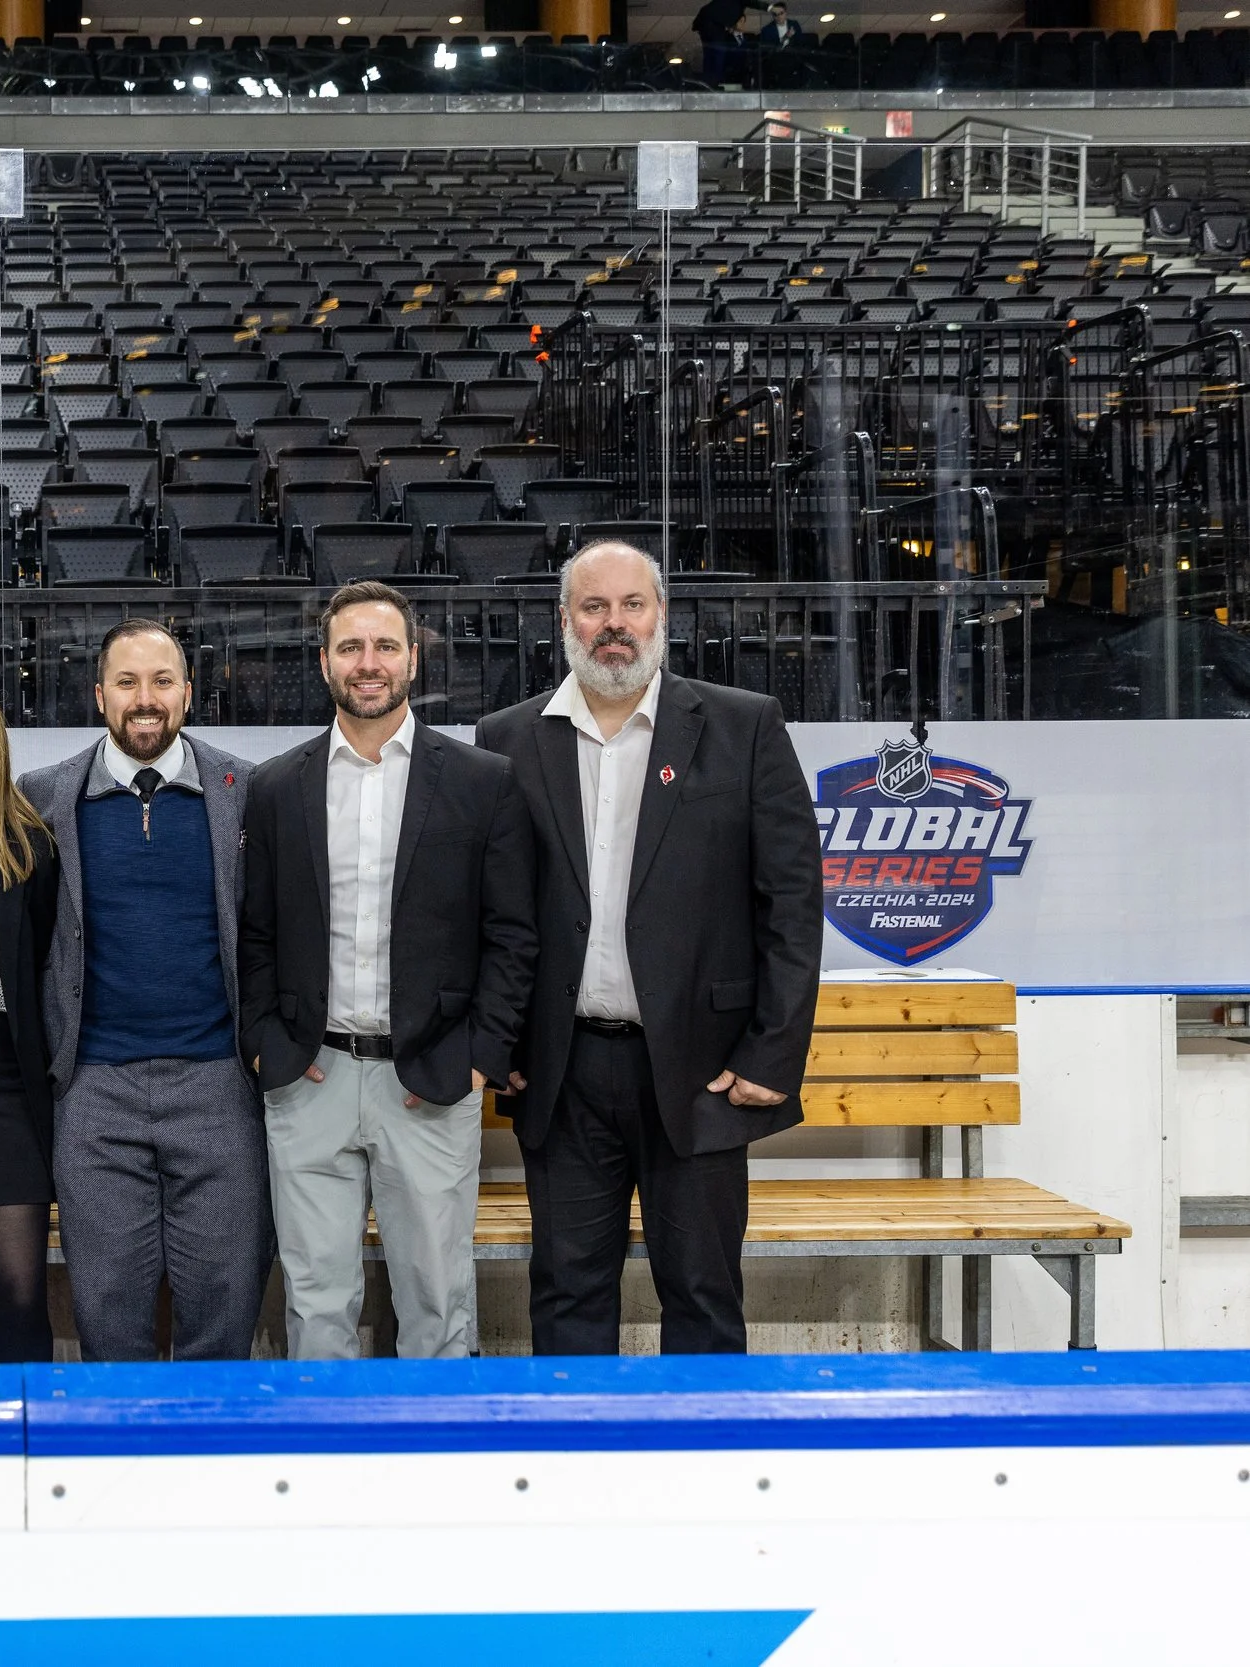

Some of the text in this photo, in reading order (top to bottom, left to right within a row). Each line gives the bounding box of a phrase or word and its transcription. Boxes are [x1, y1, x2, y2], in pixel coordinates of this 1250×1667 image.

[888, 757, 925, 789] NHL
[822, 856, 984, 886] SERIES
[836, 893, 975, 907] CZECHIA 2024
[870, 912, 943, 929] FASTENAL
